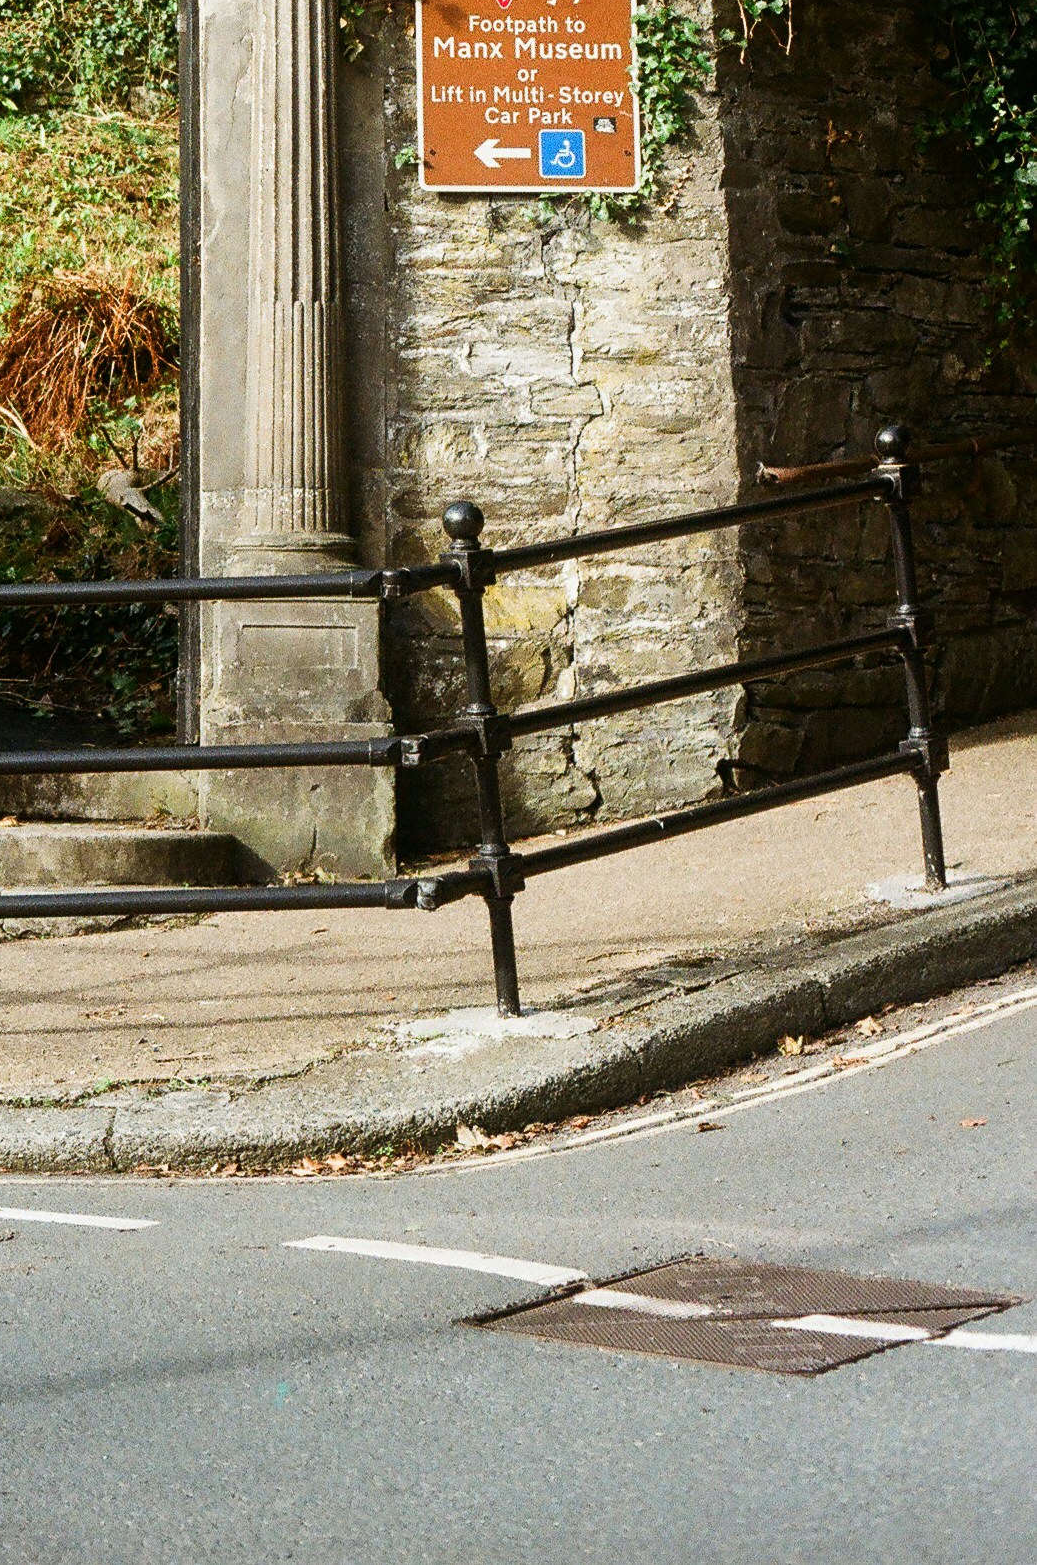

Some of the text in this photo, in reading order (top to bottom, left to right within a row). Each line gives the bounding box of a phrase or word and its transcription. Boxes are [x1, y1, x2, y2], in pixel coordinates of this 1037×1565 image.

[469, 15, 585, 35] Footpath to
[434, 37, 622, 59] Manx Museum
[518, 69, 537, 82] or
[431, 85, 463, 102] Lift
[470, 86, 486, 102] in
[485, 107, 572, 124] Car Park
